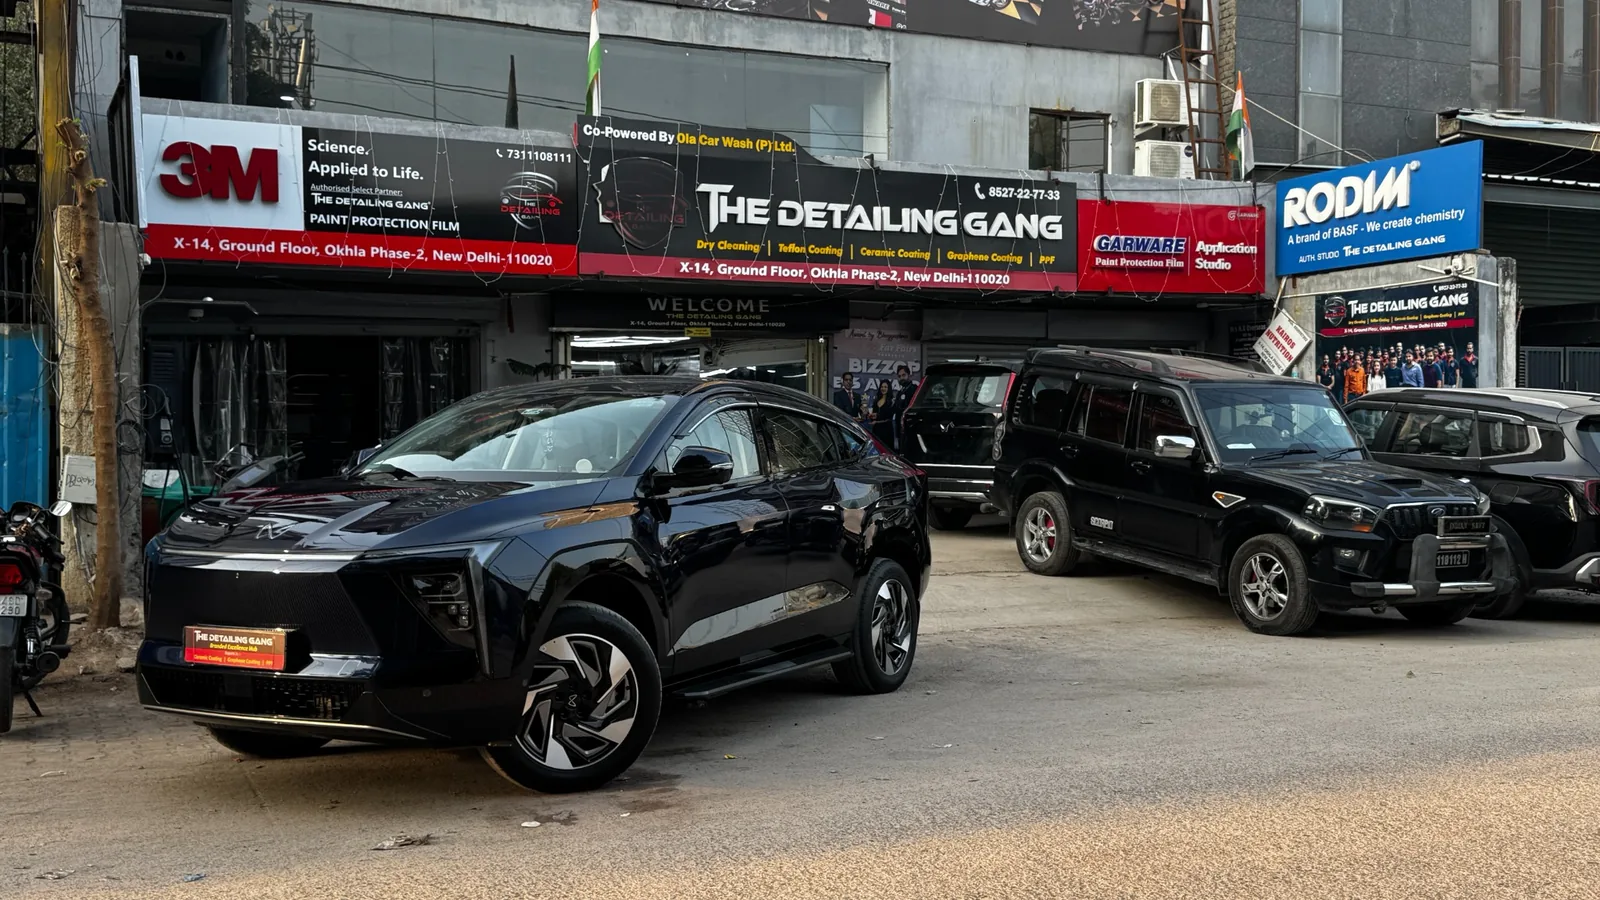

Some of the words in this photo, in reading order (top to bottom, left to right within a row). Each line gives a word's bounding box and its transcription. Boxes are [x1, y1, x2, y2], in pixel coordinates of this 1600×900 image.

[583, 124, 656, 142] Co-Powered
[659, 132, 675, 144] By
[677, 132, 696, 144] Ola
[700, 135, 720, 146] Car
[722, 137, 753, 149] Wash
[756, 140, 772, 152] (P)
[774, 141, 796, 152] Ltd.
[308, 139, 369, 155] Science.
[507, 149, 571, 163] 7311108111
[160, 141, 279, 203] 3M
[308, 161, 368, 177] Applied
[373, 166, 388, 177] to
[393, 166, 424, 180] Life.
[311, 184, 350, 192] Authorised
[352, 186, 373, 194] Select
[374, 188, 403, 196] Partner:
[989, 187, 1060, 200] 8527-22-77-33
[311, 193, 333, 205] THE
[335, 196, 393, 208] DETAILING
[395, 201, 428, 210] GANG
[500, 206, 560, 215] DETAILING
[696, 183, 771, 233] THE
[778, 200, 957, 236] DETAILING
[963, 211, 1063, 240] GANG
[310, 214, 348, 225] PAINT
[352, 216, 428, 229] PROTECTION
[432, 221, 460, 231] FILM
[1288, 236, 1294, 245] A
[1296, 231, 1320, 244] brand
[1322, 228, 1332, 240] of
[1334, 224, 1358, 238] BASF
[1366, 221, 1380, 233] We
[1382, 217, 1412, 230] create
[1415, 209, 1465, 225] chemistry
[174, 237, 214, 252] X-14,
[219, 239, 275, 254] Ground
[280, 242, 320, 256] Floor,
[324, 244, 366, 257] Okhla
[371, 246, 428, 261] Phase-2,
[433, 250, 462, 261] New
[467, 252, 552, 265] Delhi-110020
[696, 240, 714, 250] Dry
[718, 241, 760, 253] Cleaning
[778, 244, 806, 253] Teflon
[808, 245, 843, 256] Coating
[1094, 235, 1186, 253] GARWARE
[1196, 240, 1257, 255] Application
[1317, 251, 1339, 261] STUDIO
[1343, 245, 1360, 257] THE
[1363, 240, 1412, 254] DETAILING
[1414, 235, 1446, 246] GANG
[860, 248, 895, 257] Ceramic
[898, 249, 931, 260] Coating
[947, 252, 989, 263] Graphene
[991, 253, 1022, 264] Coating
[1040, 256, 1055, 264] PPF
[1096, 257, 1118, 266] Paint
[1120, 258, 1164, 267] Protection
[1166, 259, 1184, 267] Film
[1195, 257, 1232, 270] Studio
[680, 262, 713, 275] X-14,
[718, 264, 767, 276] Ground
[771, 266, 807, 279] Floor,
[811, 268, 848, 279] Okhla
[852, 270, 900, 282] Phase-2,
[904, 271, 931, 282] New
[934, 272, 1010, 284] Delhi-110020
[648, 298, 769, 312] WELCOME
[1348, 300, 1368, 318] THE
[1370, 298, 1428, 313] DETAILING
[1429, 292, 1469, 308] GANG
[1276, 325, 1296, 349] KAIROS
[1264, 329, 1294, 362] NUTRITION
[194, 630, 208, 642] THE
[209, 634, 248, 644] DETAILING
[249, 637, 273, 646] GANG
[227, 656, 245, 664] Graphene
